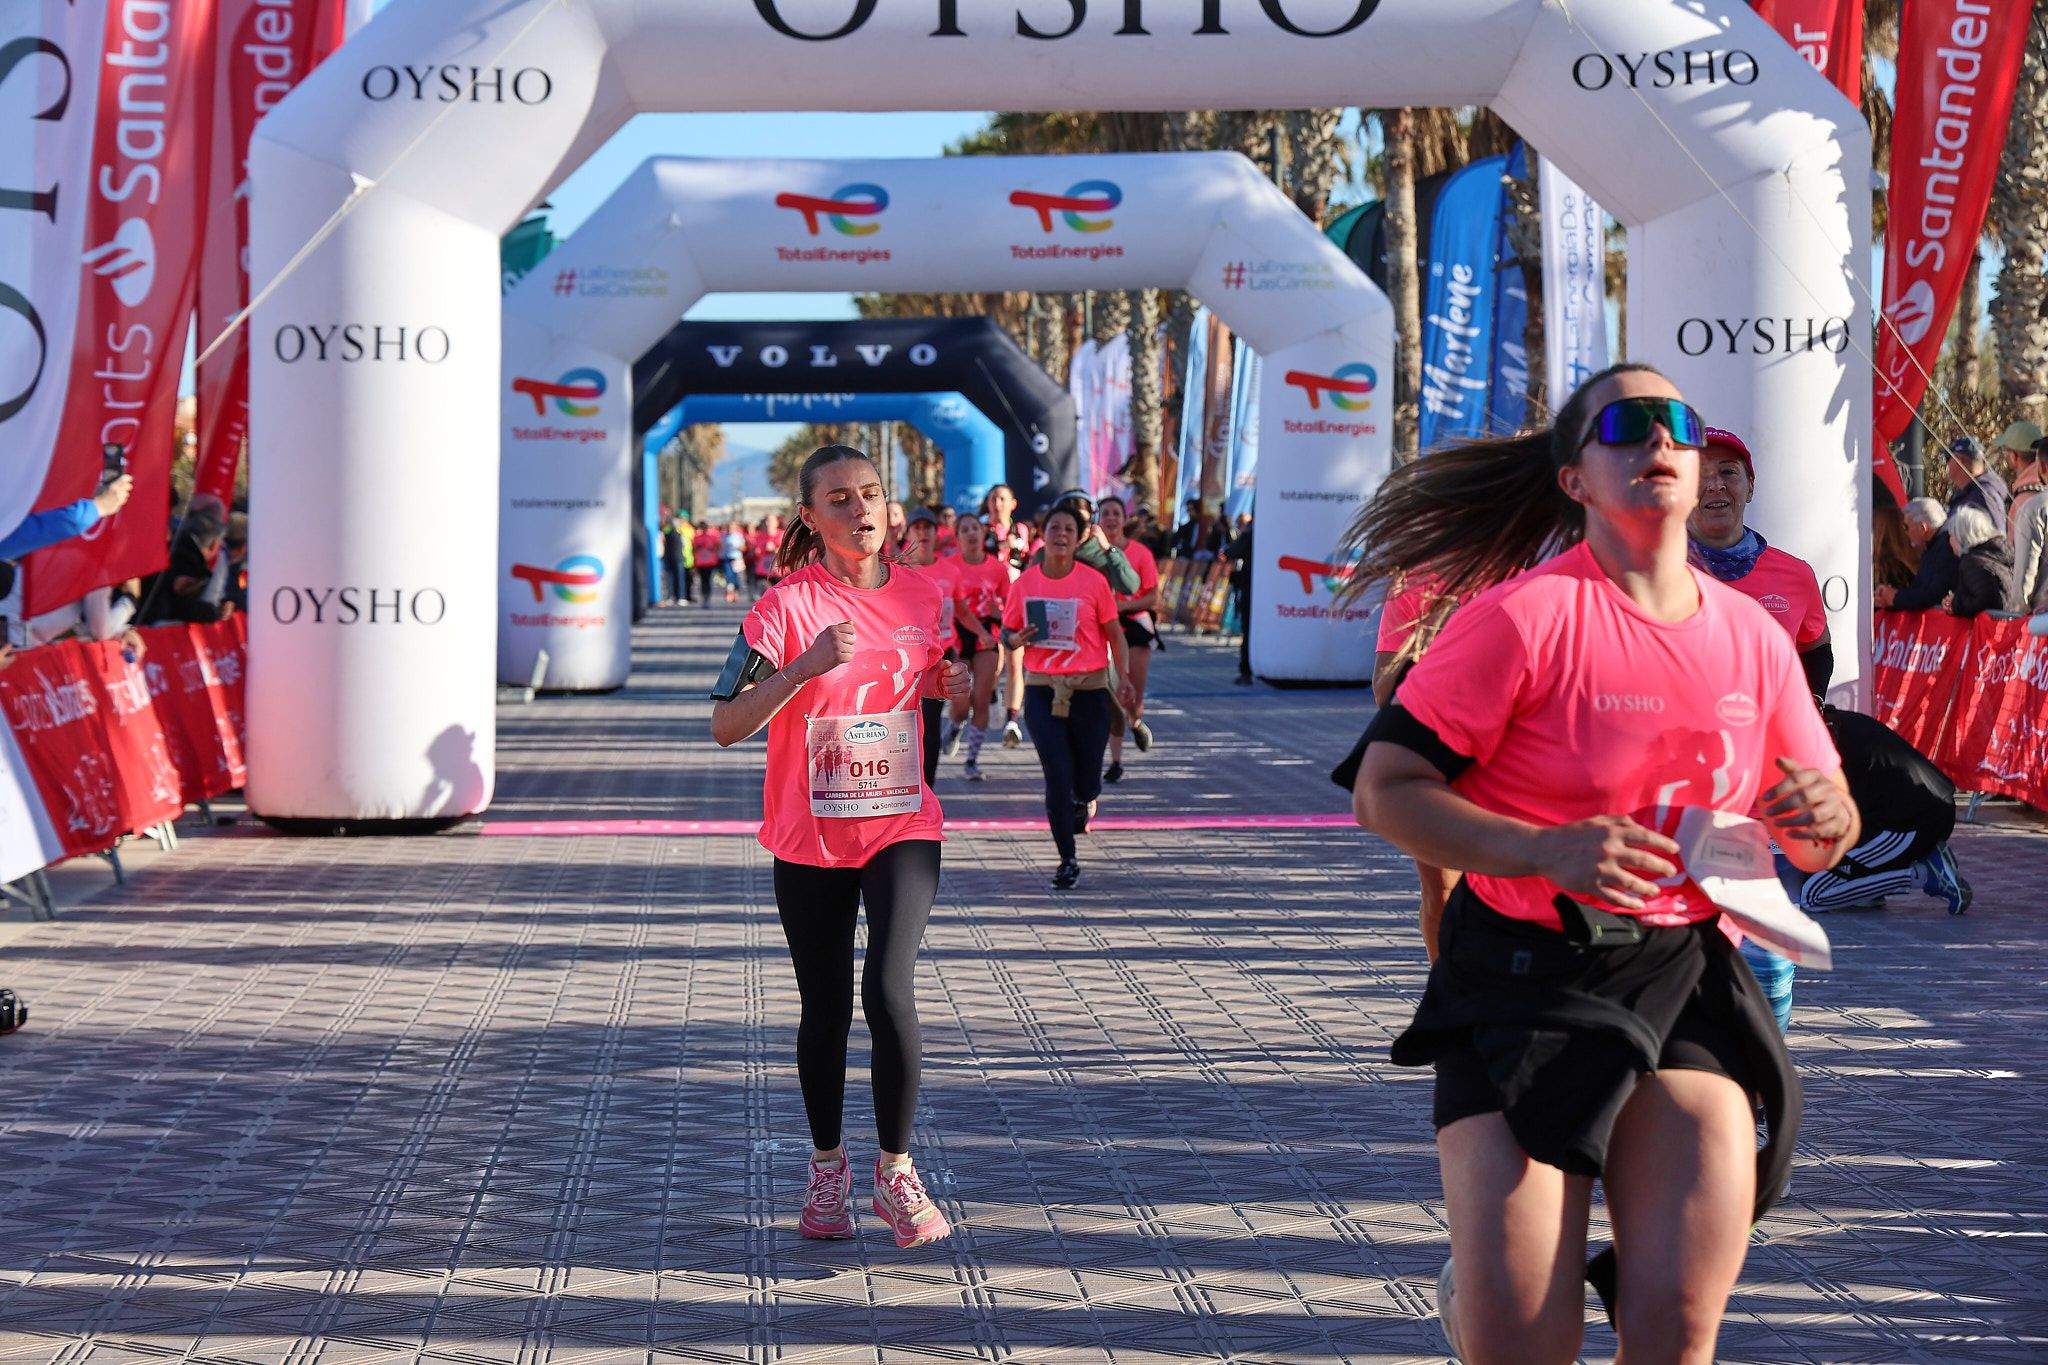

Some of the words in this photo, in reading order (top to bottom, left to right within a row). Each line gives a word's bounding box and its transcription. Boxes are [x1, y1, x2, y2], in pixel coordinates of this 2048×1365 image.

[1573, 50, 1759, 91] OYSHO
[362, 65, 552, 105] OYSHO
[1906, 0, 1991, 272] Santander
[776, 247, 891, 264] TotalEnergies
[1010, 244, 1124, 260] TotalEnergies
[275, 324, 450, 363] OYSHO
[1423, 263, 1487, 419] Marlene
[1677, 317, 1850, 356] OYSHO
[706, 343, 938, 368] VOLVO
[512, 426, 607, 444] TotalEnergies
[1283, 421, 1376, 437] TotalEnergies
[272, 586, 445, 625] OYSHO
[510, 612, 607, 630] TotalEnergies
[1595, 694, 1664, 714] OYSHO
[847, 731, 887, 740] ASTURIANA
[849, 760, 890, 777] 016
[858, 781, 878, 789] 5714
[823, 803, 859, 811] OYSHO
[880, 800, 911, 809] Santander
